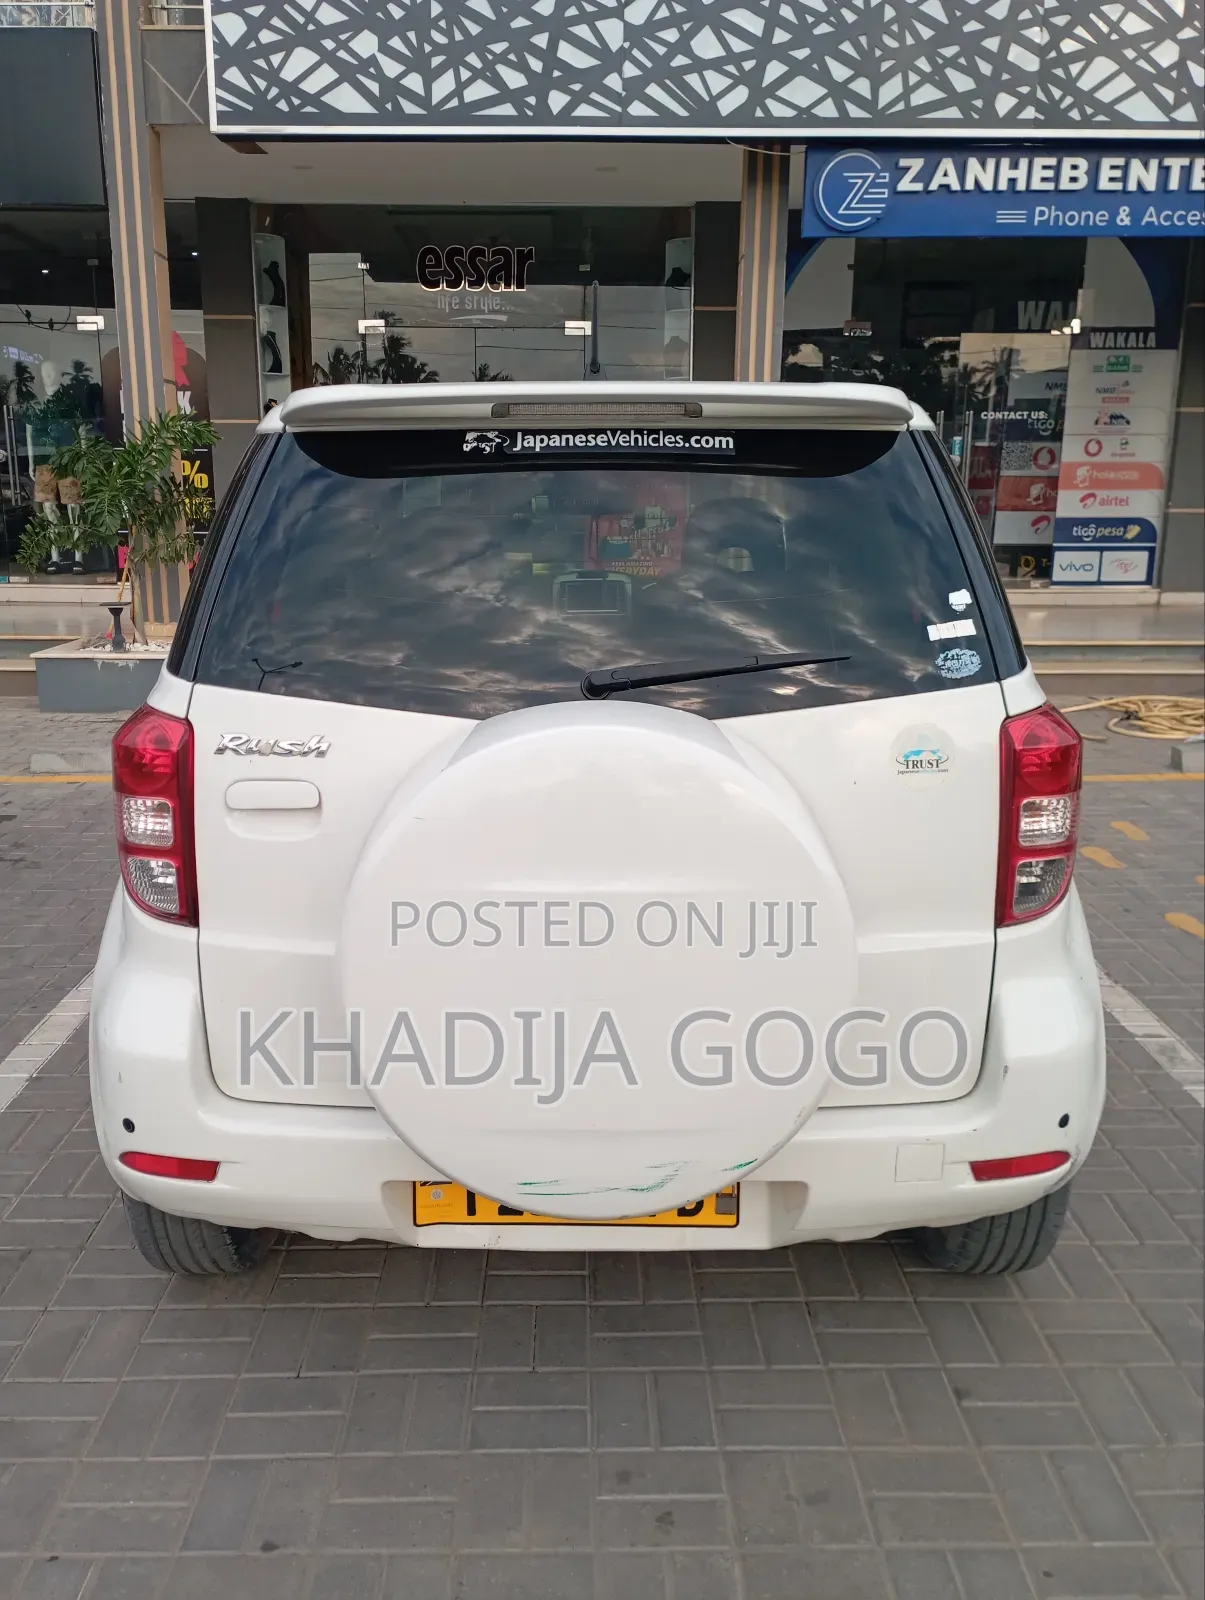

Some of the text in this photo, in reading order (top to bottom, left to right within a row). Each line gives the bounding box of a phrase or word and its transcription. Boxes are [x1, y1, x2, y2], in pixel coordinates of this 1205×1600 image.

[896, 157, 1205, 192] ZANHEB ENTE
[1033, 205, 1205, 227] Phone & Acce
[416, 245, 535, 293] essar
[437, 293, 460, 313] life
[1089, 331, 1157, 349] WAKALA
[980, 410, 1049, 420] CONTACT US:
[512, 429, 735, 452] JapaneseVehicles.com
[1098, 495, 1130, 507] airtel
[605, 566, 661, 576] VERYDAY
[1059, 561, 1094, 572] vivo
[213, 732, 332, 758] Rush
[903, 759, 941, 770] TRUST
